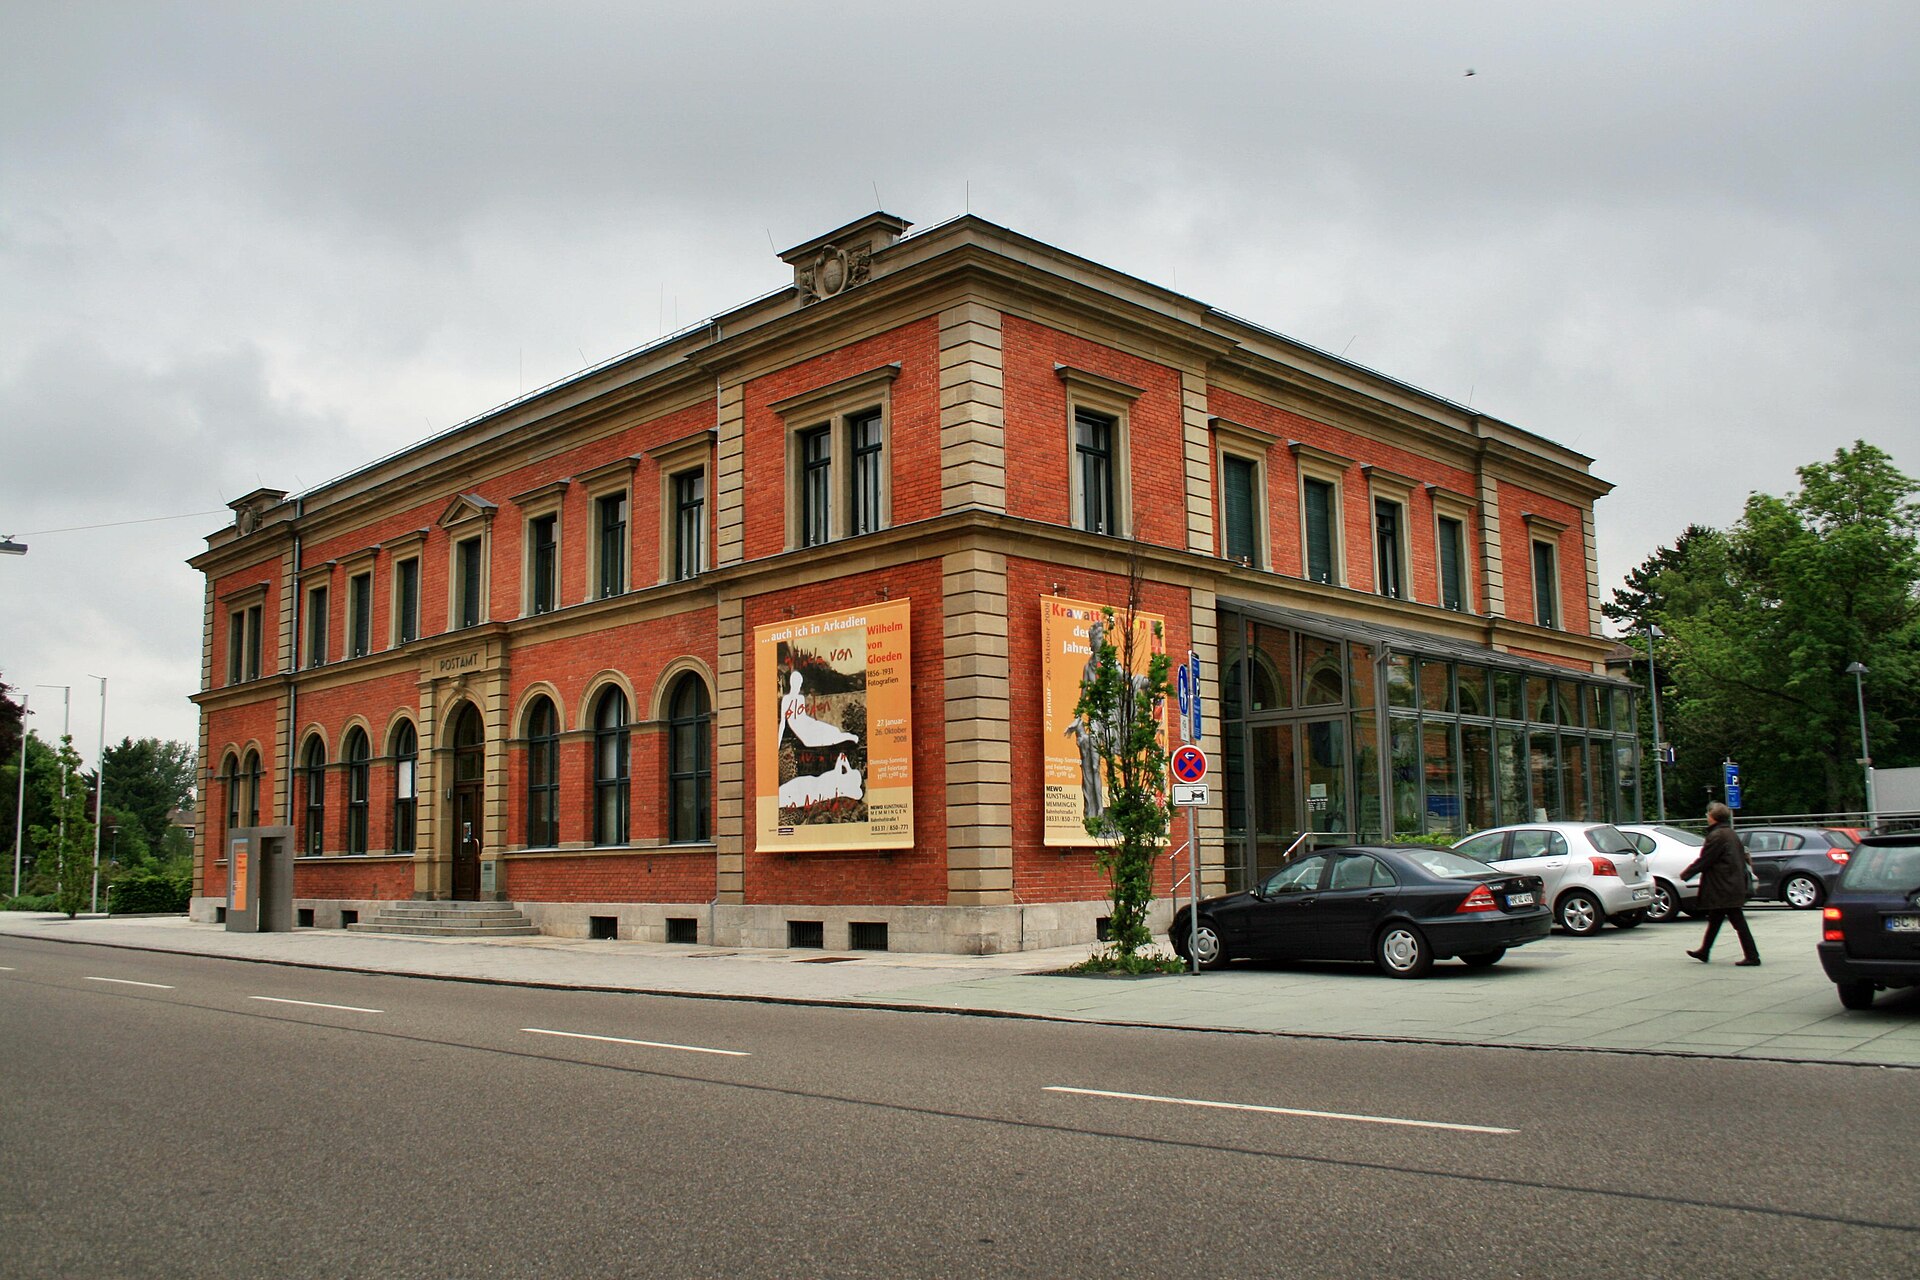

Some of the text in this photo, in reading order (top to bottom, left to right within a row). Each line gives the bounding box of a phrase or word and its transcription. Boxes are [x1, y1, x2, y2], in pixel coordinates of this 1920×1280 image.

[795, 626, 808, 637] ich
[811, 624, 820, 634] in
[823, 616, 866, 632] Arkadien
[867, 622, 903, 635] Wilhelm
[867, 641, 882, 650] von
[1063, 640, 1094, 655] Jahres
[830, 648, 853, 662] von
[867, 651, 902, 664] Gloeden
[440, 653, 478, 672] POSTAMT
[867, 677, 899, 687] Fotografien
[884, 726, 907, 735] Oktober
[1670, 747, 1675, 762] 1
[1893, 915, 1909, 928] BC
